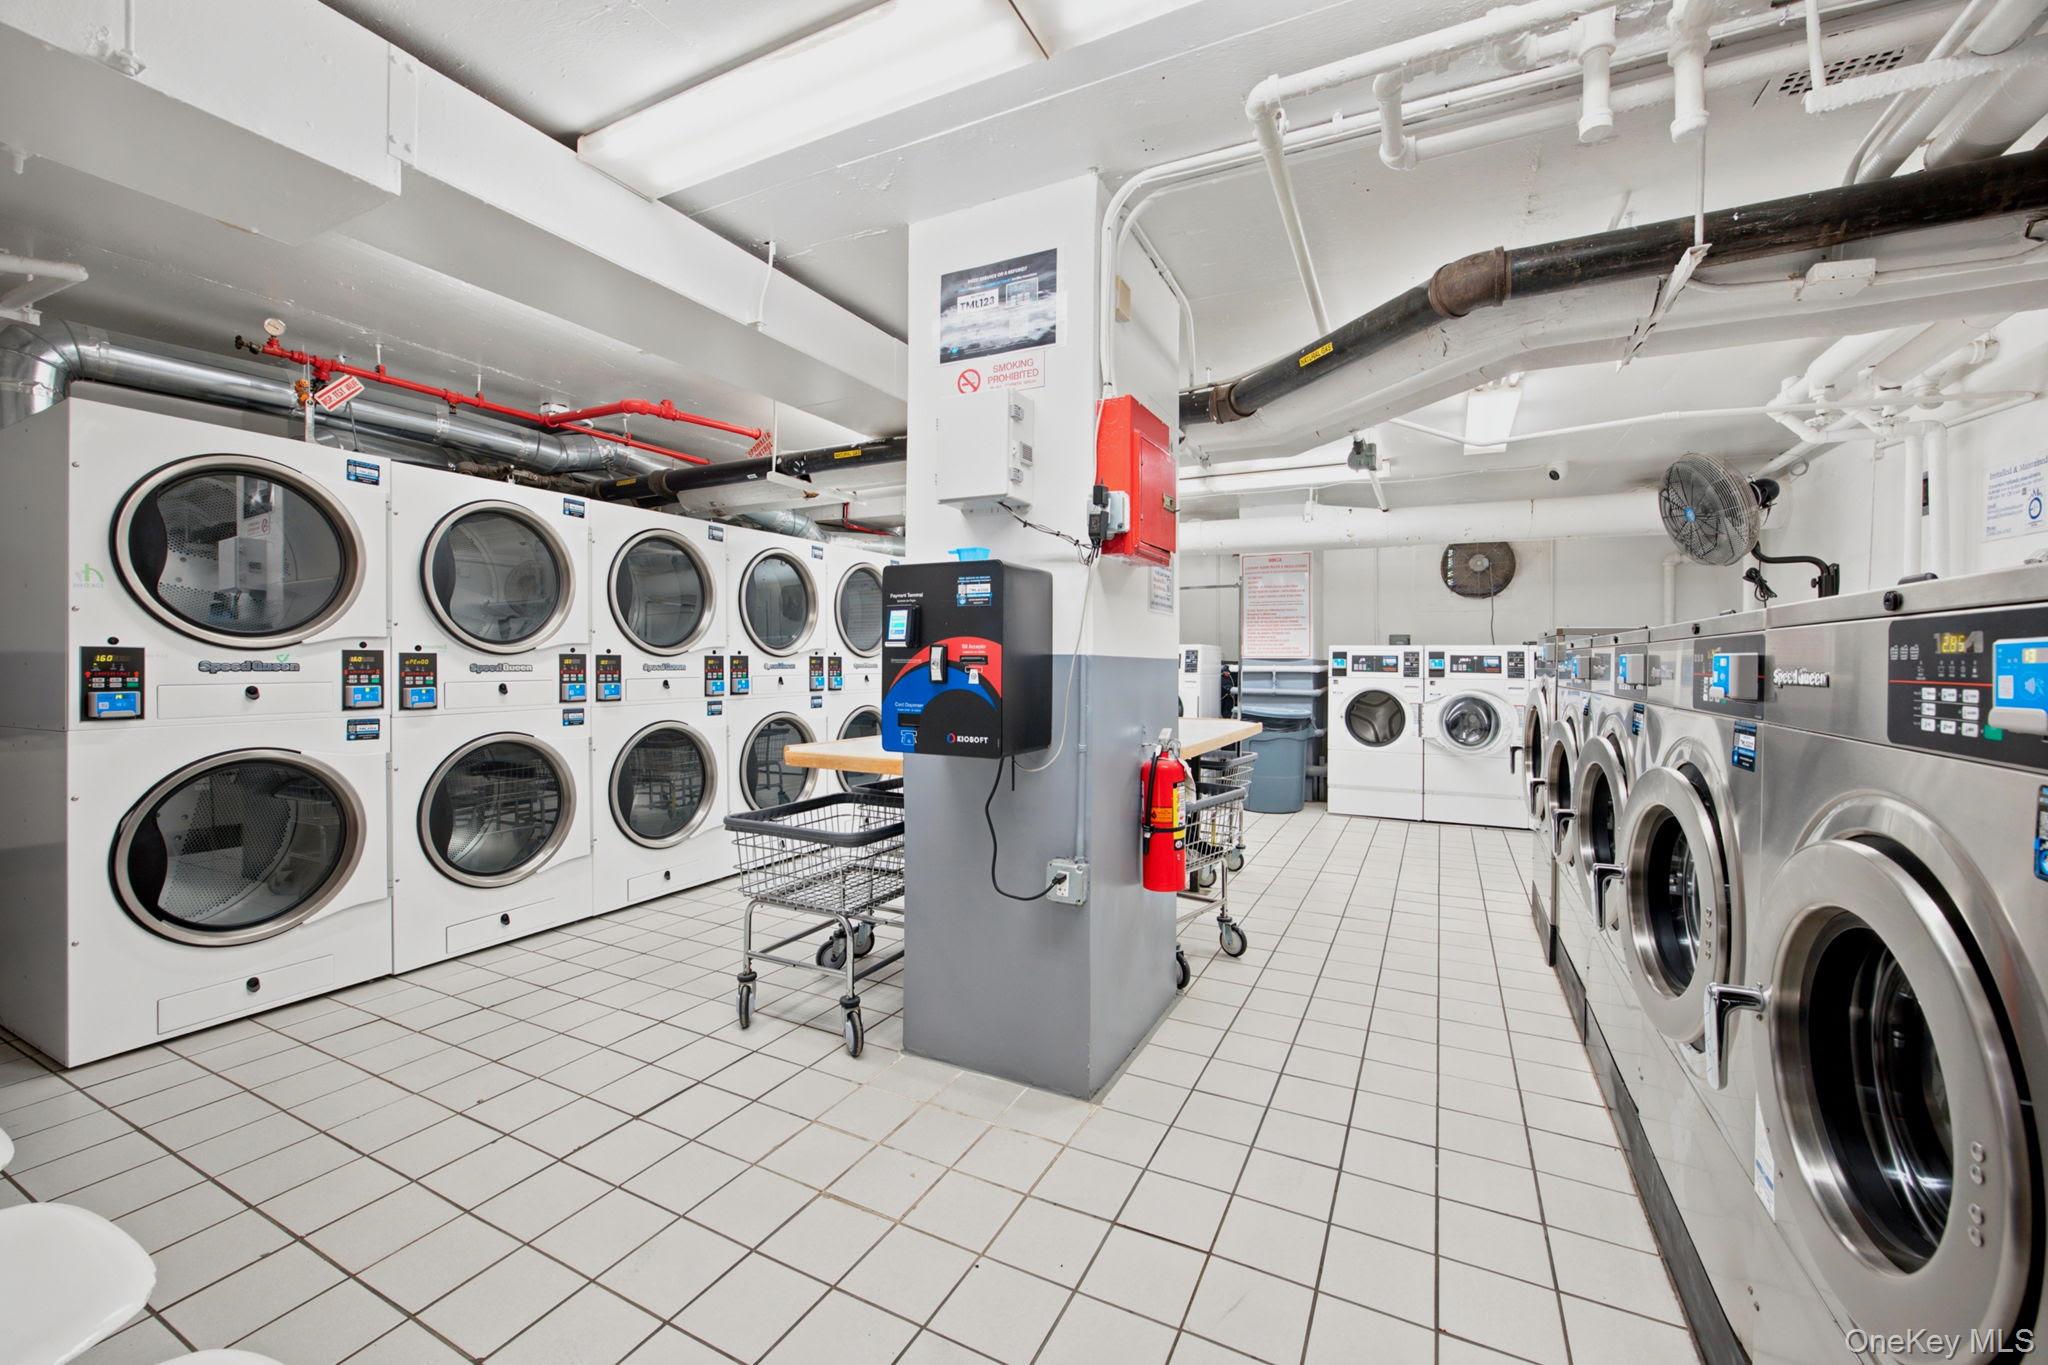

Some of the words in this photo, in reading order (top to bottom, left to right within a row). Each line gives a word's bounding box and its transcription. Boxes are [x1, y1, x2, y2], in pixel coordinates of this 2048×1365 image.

[960, 296, 995, 310] TML123
[993, 358, 1034, 373] SMOKING
[987, 368, 1039, 384] PROHIBITED
[957, 736, 989, 744] KIOSOFT
